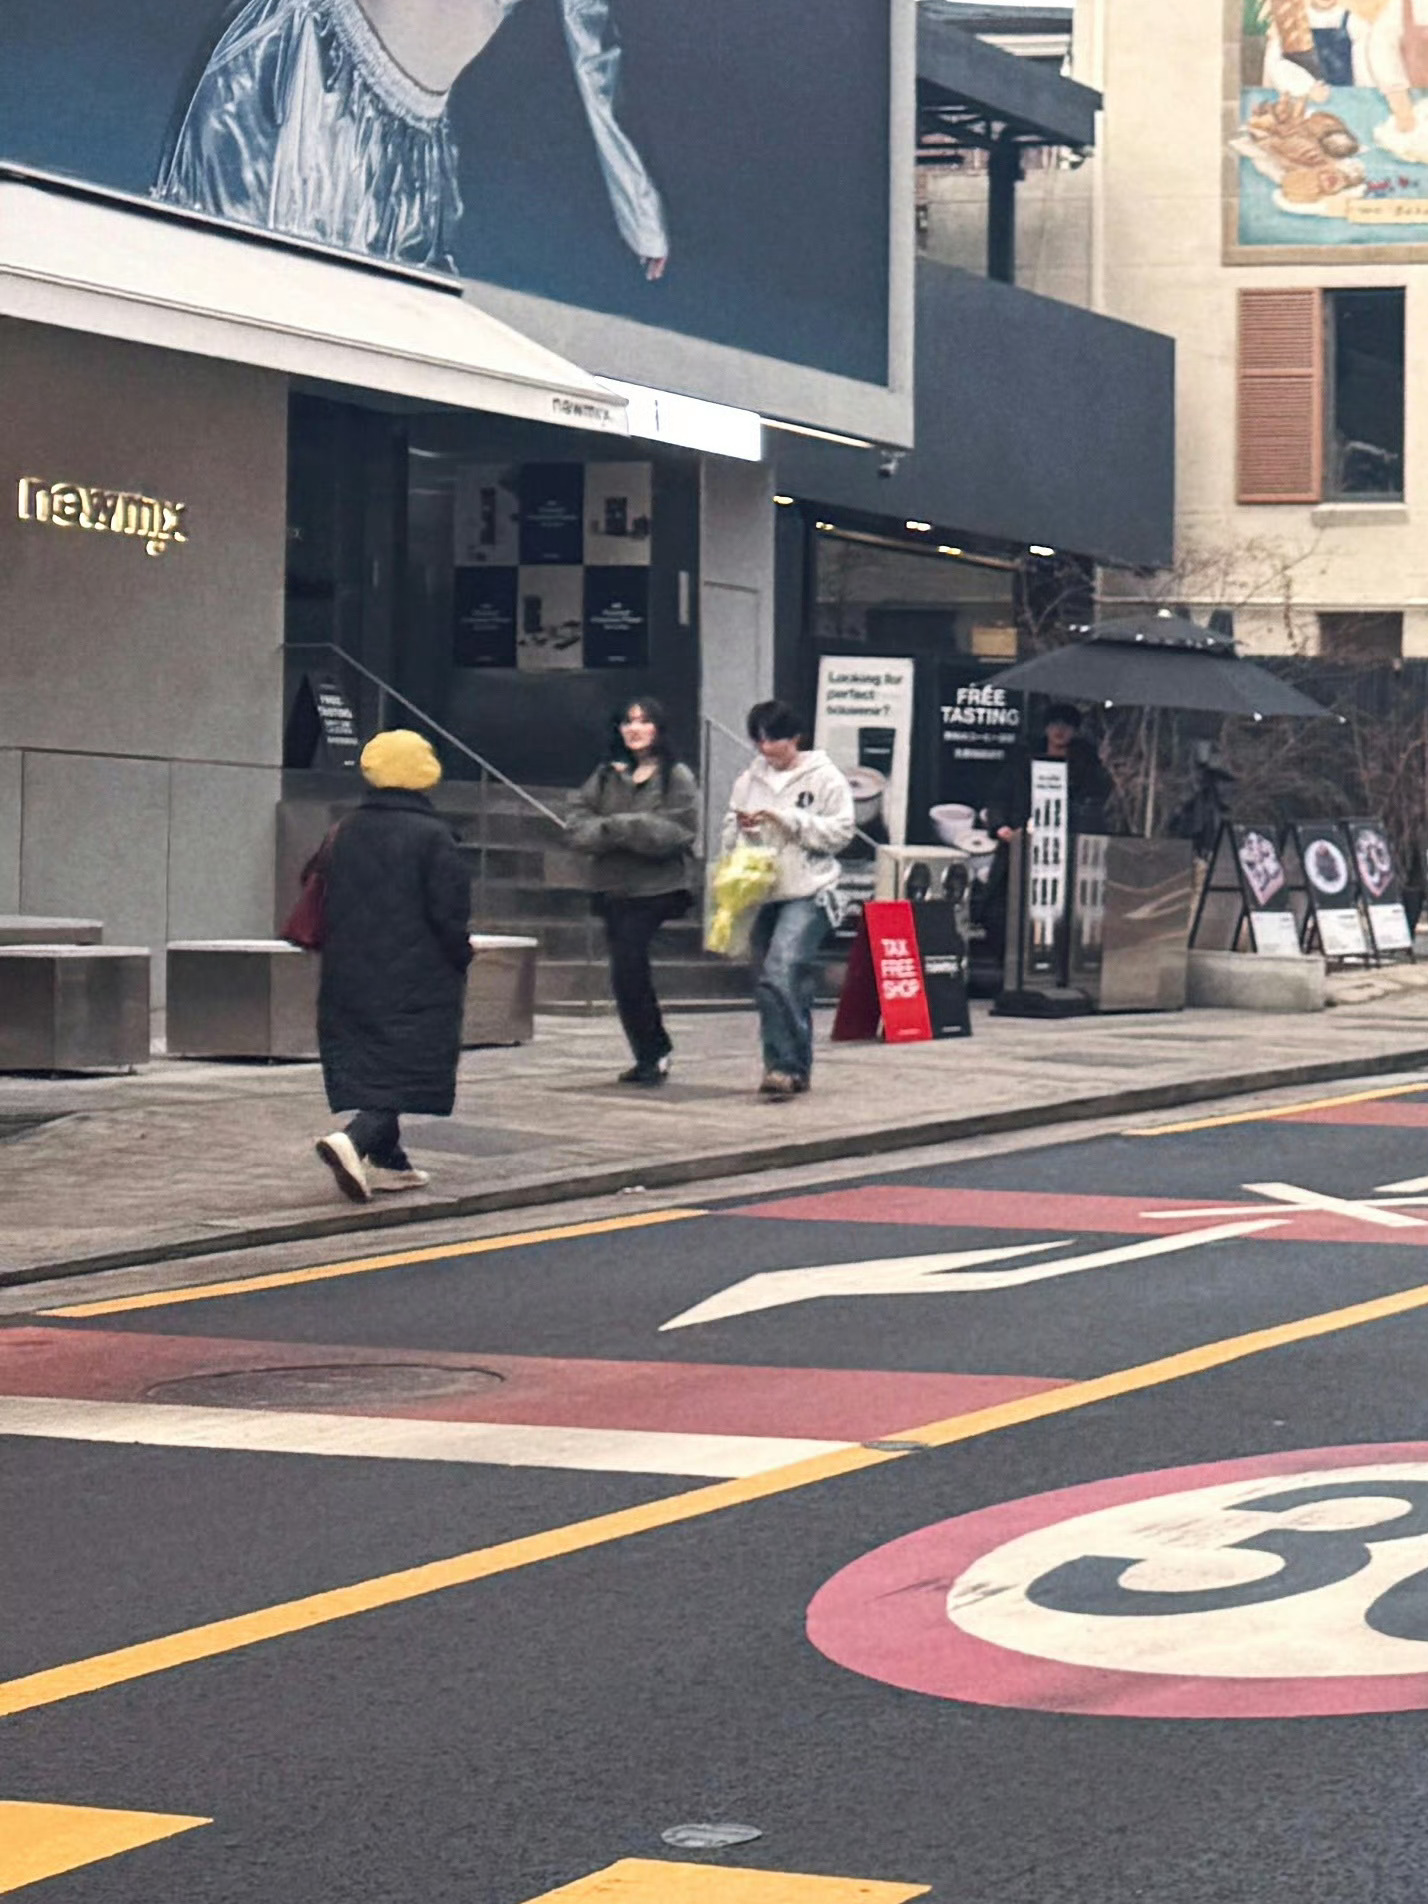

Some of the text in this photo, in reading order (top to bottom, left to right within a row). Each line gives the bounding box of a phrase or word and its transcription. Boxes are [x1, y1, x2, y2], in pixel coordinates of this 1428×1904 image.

[956, 687, 1006, 707] FREE
[941, 706, 1019, 726] TASTING
[881, 938, 909, 956] TAX
[881, 958, 917, 978] FREE
[882, 978, 920, 1000] SHOP
